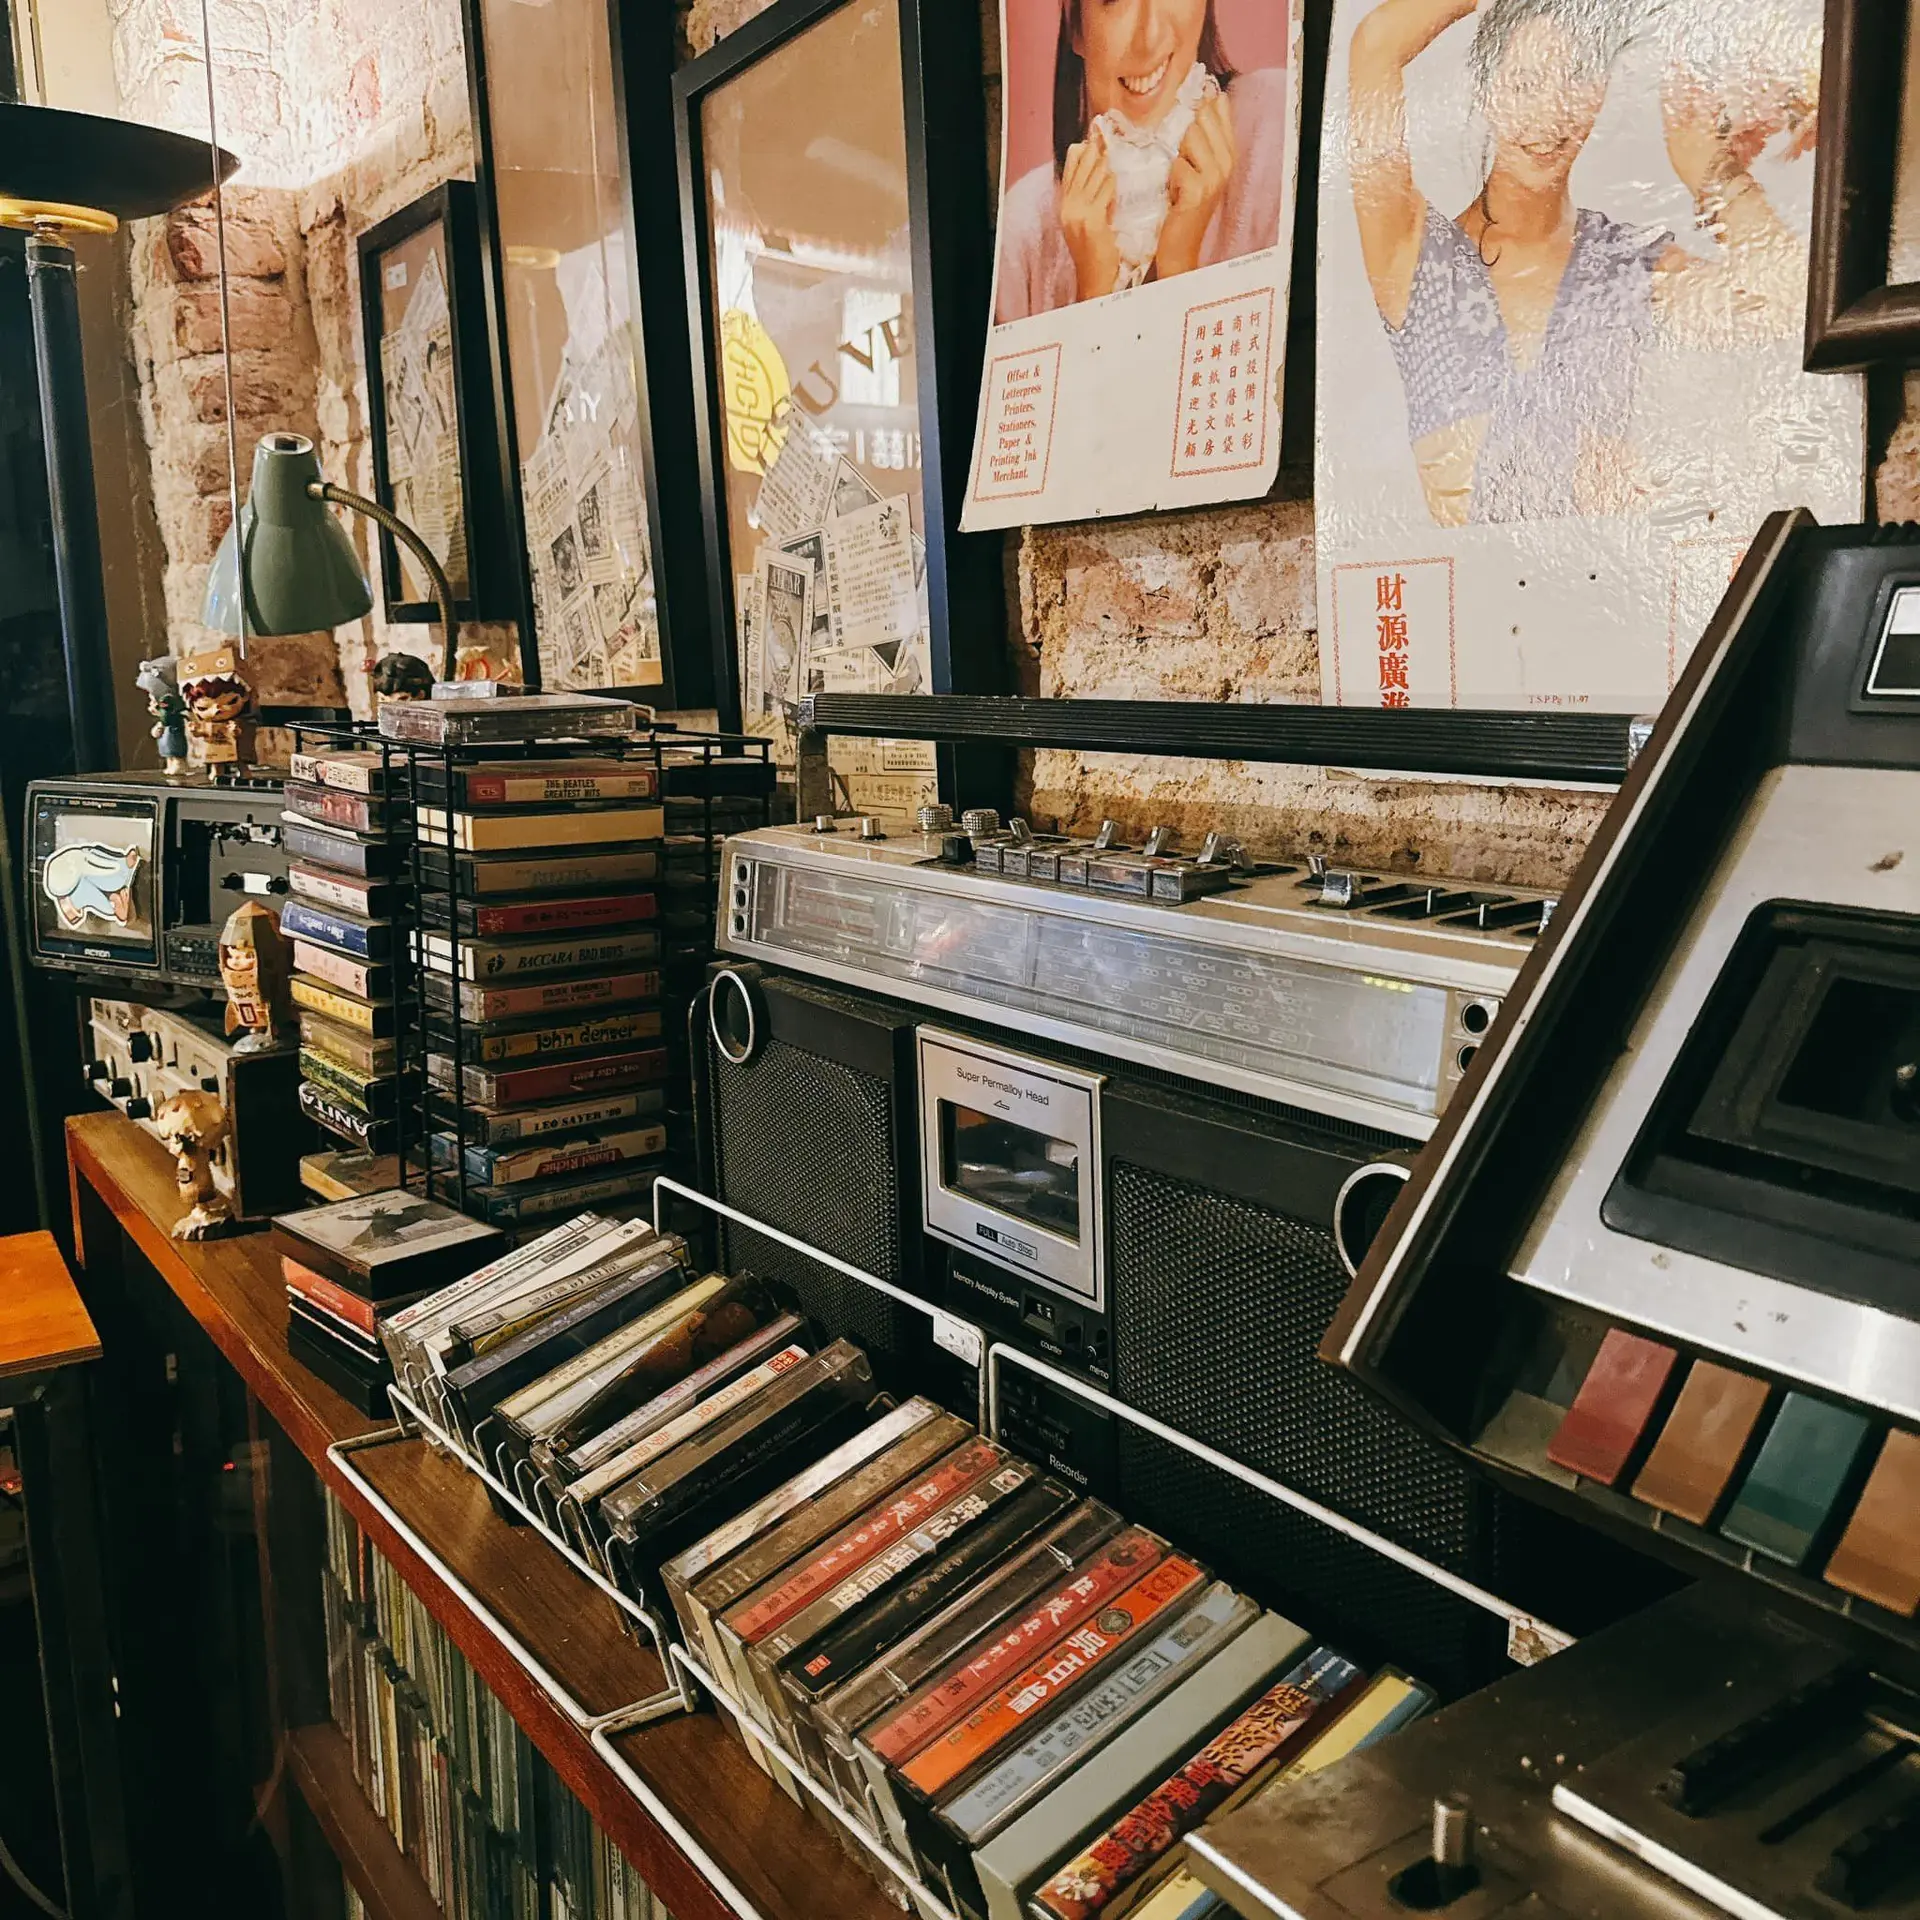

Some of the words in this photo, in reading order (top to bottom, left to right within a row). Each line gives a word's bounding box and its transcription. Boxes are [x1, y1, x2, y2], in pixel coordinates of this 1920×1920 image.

[1007, 368, 1029, 383] Offset
[1033, 364, 1041, 378] &
[1001, 383, 1042, 401] Letterpress
[998, 436, 1021, 452] Paper
[1024, 434, 1032, 446] &
[989, 452, 1020, 469] Printing
[1024, 448, 1037, 462] Ink
[544, 789, 581, 799] GREATEST
[584, 788, 601, 798] HITS
[545, 780, 561, 789] THE
[563, 779, 596, 788] BEATLES
[518, 952, 573, 969] BACCARA
[956, 1067, 981, 1084] Super
[982, 1074, 1023, 1098] Permalloy
[1026, 1089, 1050, 1106] Head
[534, 1119, 559, 1131] LEO
[562, 1112, 602, 1127] SAYER
[978, 1225, 997, 1240] FULL
[1001, 1236, 1017, 1251] Auto
[998, 1291, 1020, 1308] System
[1050, 1454, 1088, 1486] Recorder
[1203, 1682, 1312, 1782] 還珠格格
